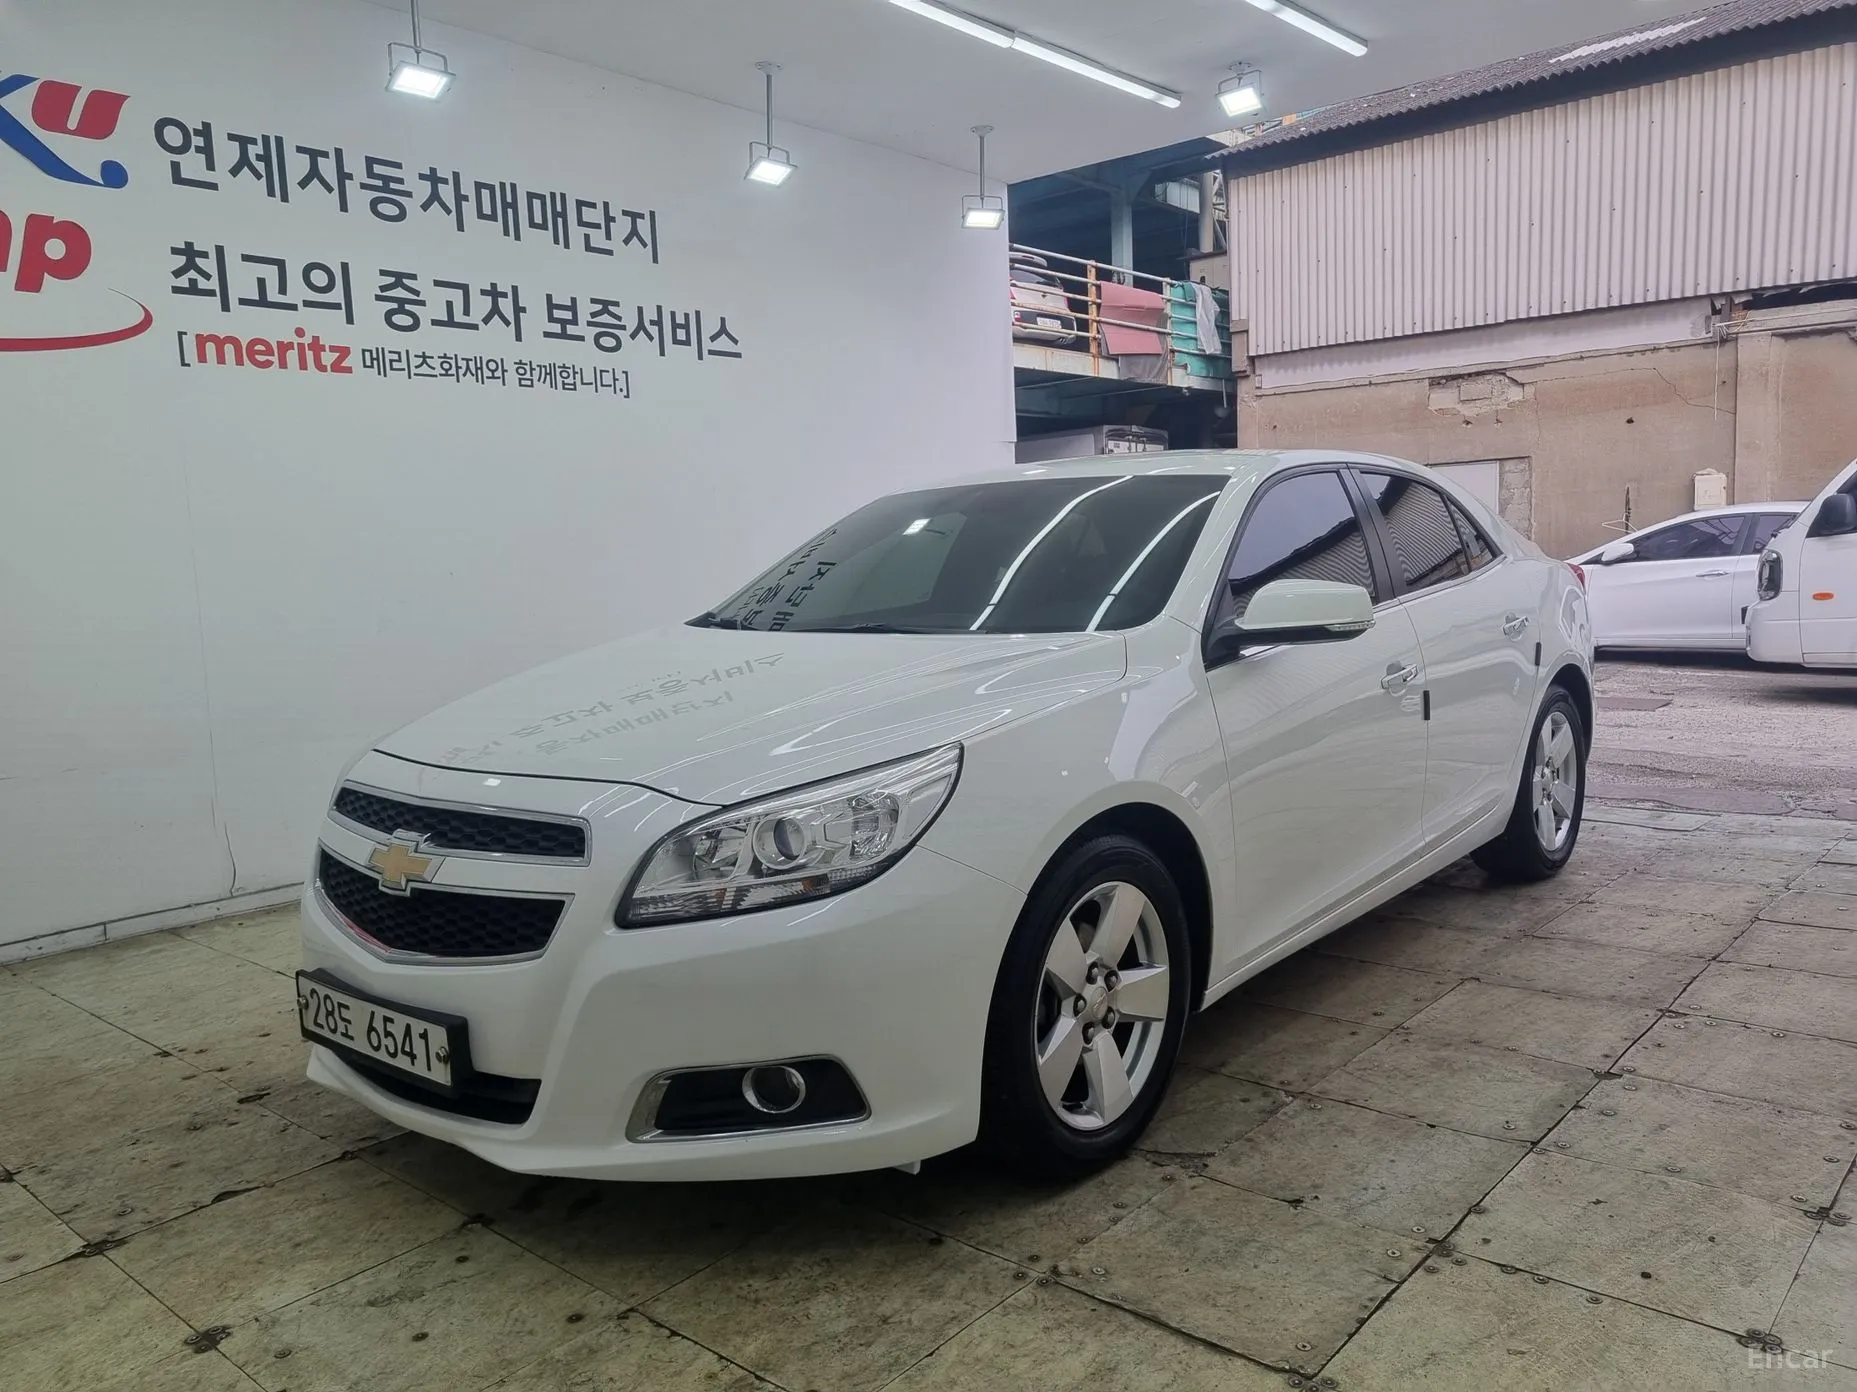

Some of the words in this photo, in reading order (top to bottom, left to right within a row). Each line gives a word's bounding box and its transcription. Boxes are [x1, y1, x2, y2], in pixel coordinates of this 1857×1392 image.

[154, 116, 660, 265] 연제자동차매매단지
[170, 240, 355, 326] 최고의
[374, 268, 528, 343] 중고차
[542, 293, 743, 361] 보증서비스
[361, 345, 508, 388] 메리츠화재와
[513, 359, 630, 399] 함께합니다.]
[309, 987, 355, 1041] 28도
[366, 1010, 432, 1072] 6541
